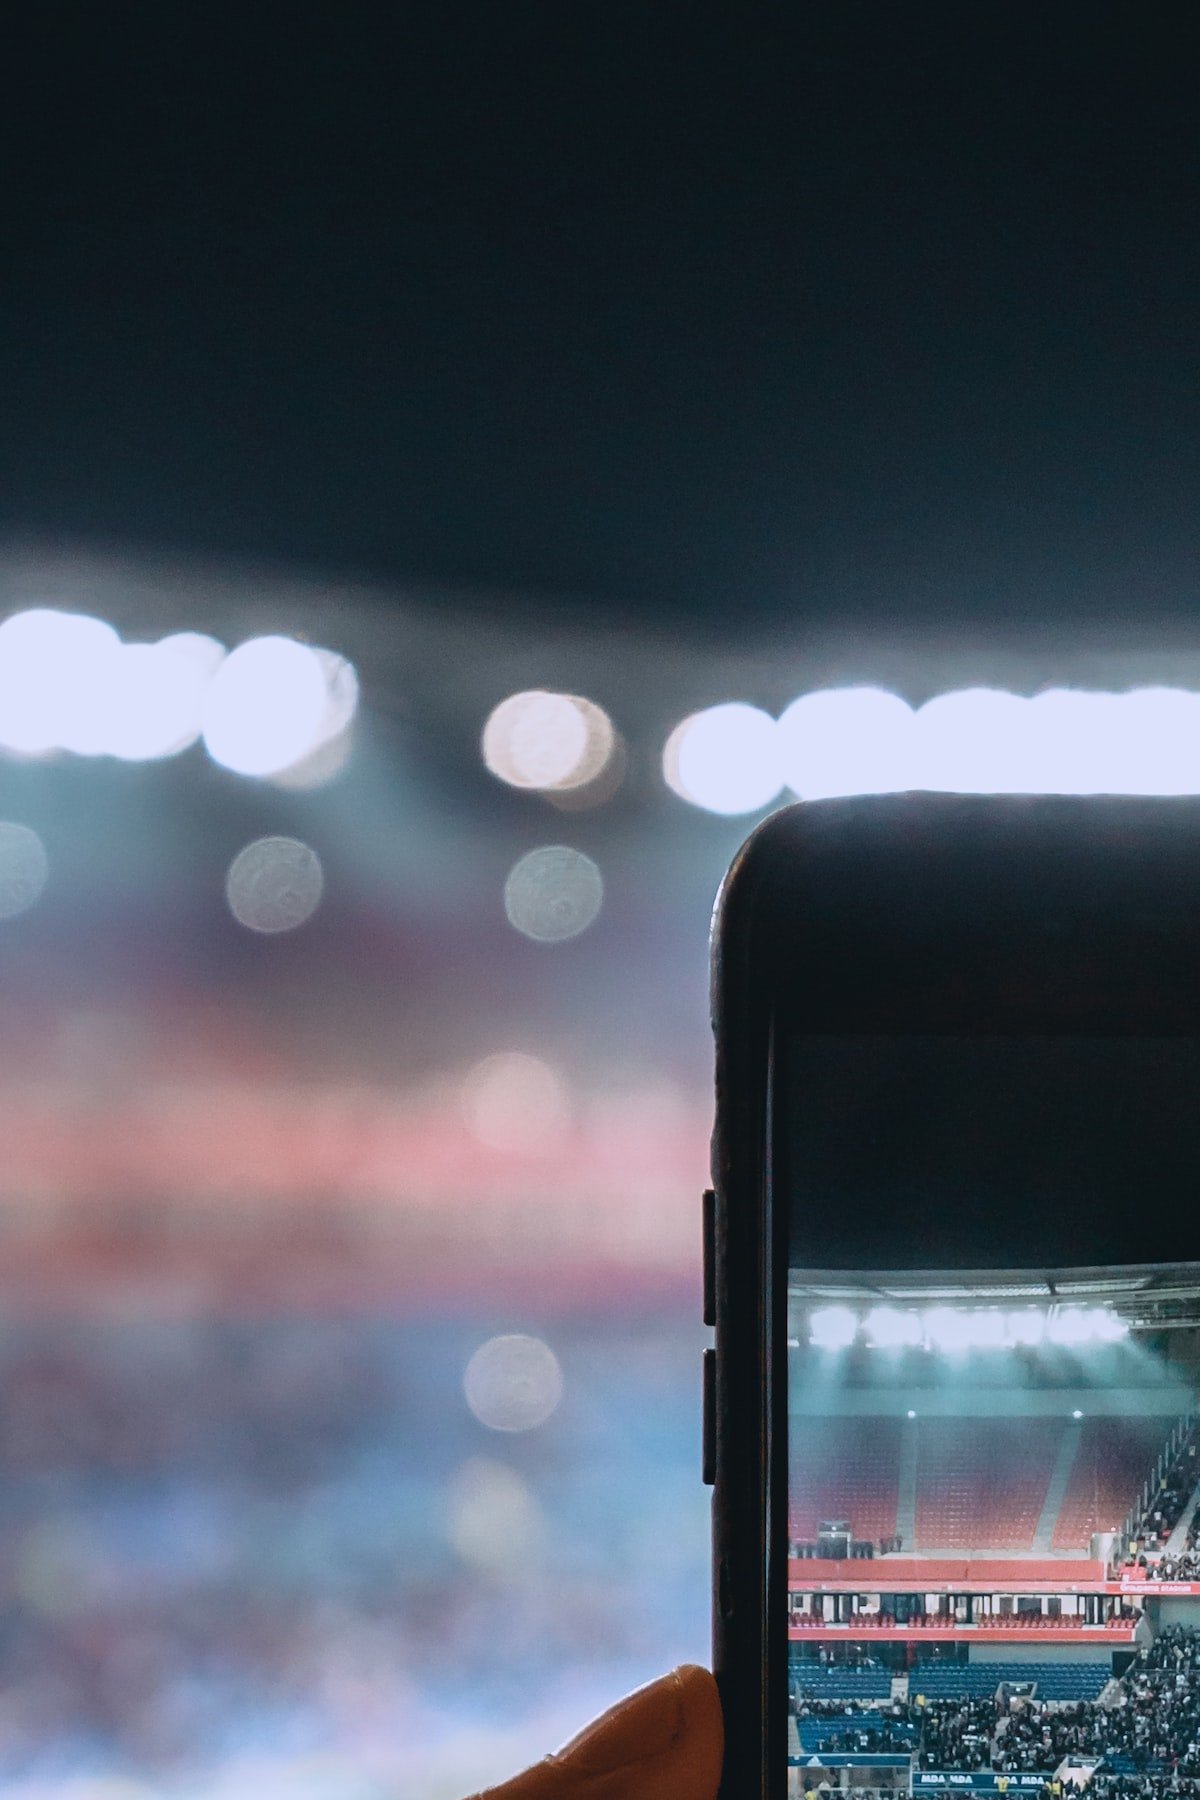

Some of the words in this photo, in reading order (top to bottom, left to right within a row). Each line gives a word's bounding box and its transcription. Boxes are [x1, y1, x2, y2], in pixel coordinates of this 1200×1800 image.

[921, 1774, 946, 1784] MDA
[949, 1775, 973, 1784] MDA
[1021, 1776, 1045, 1785] MDA
